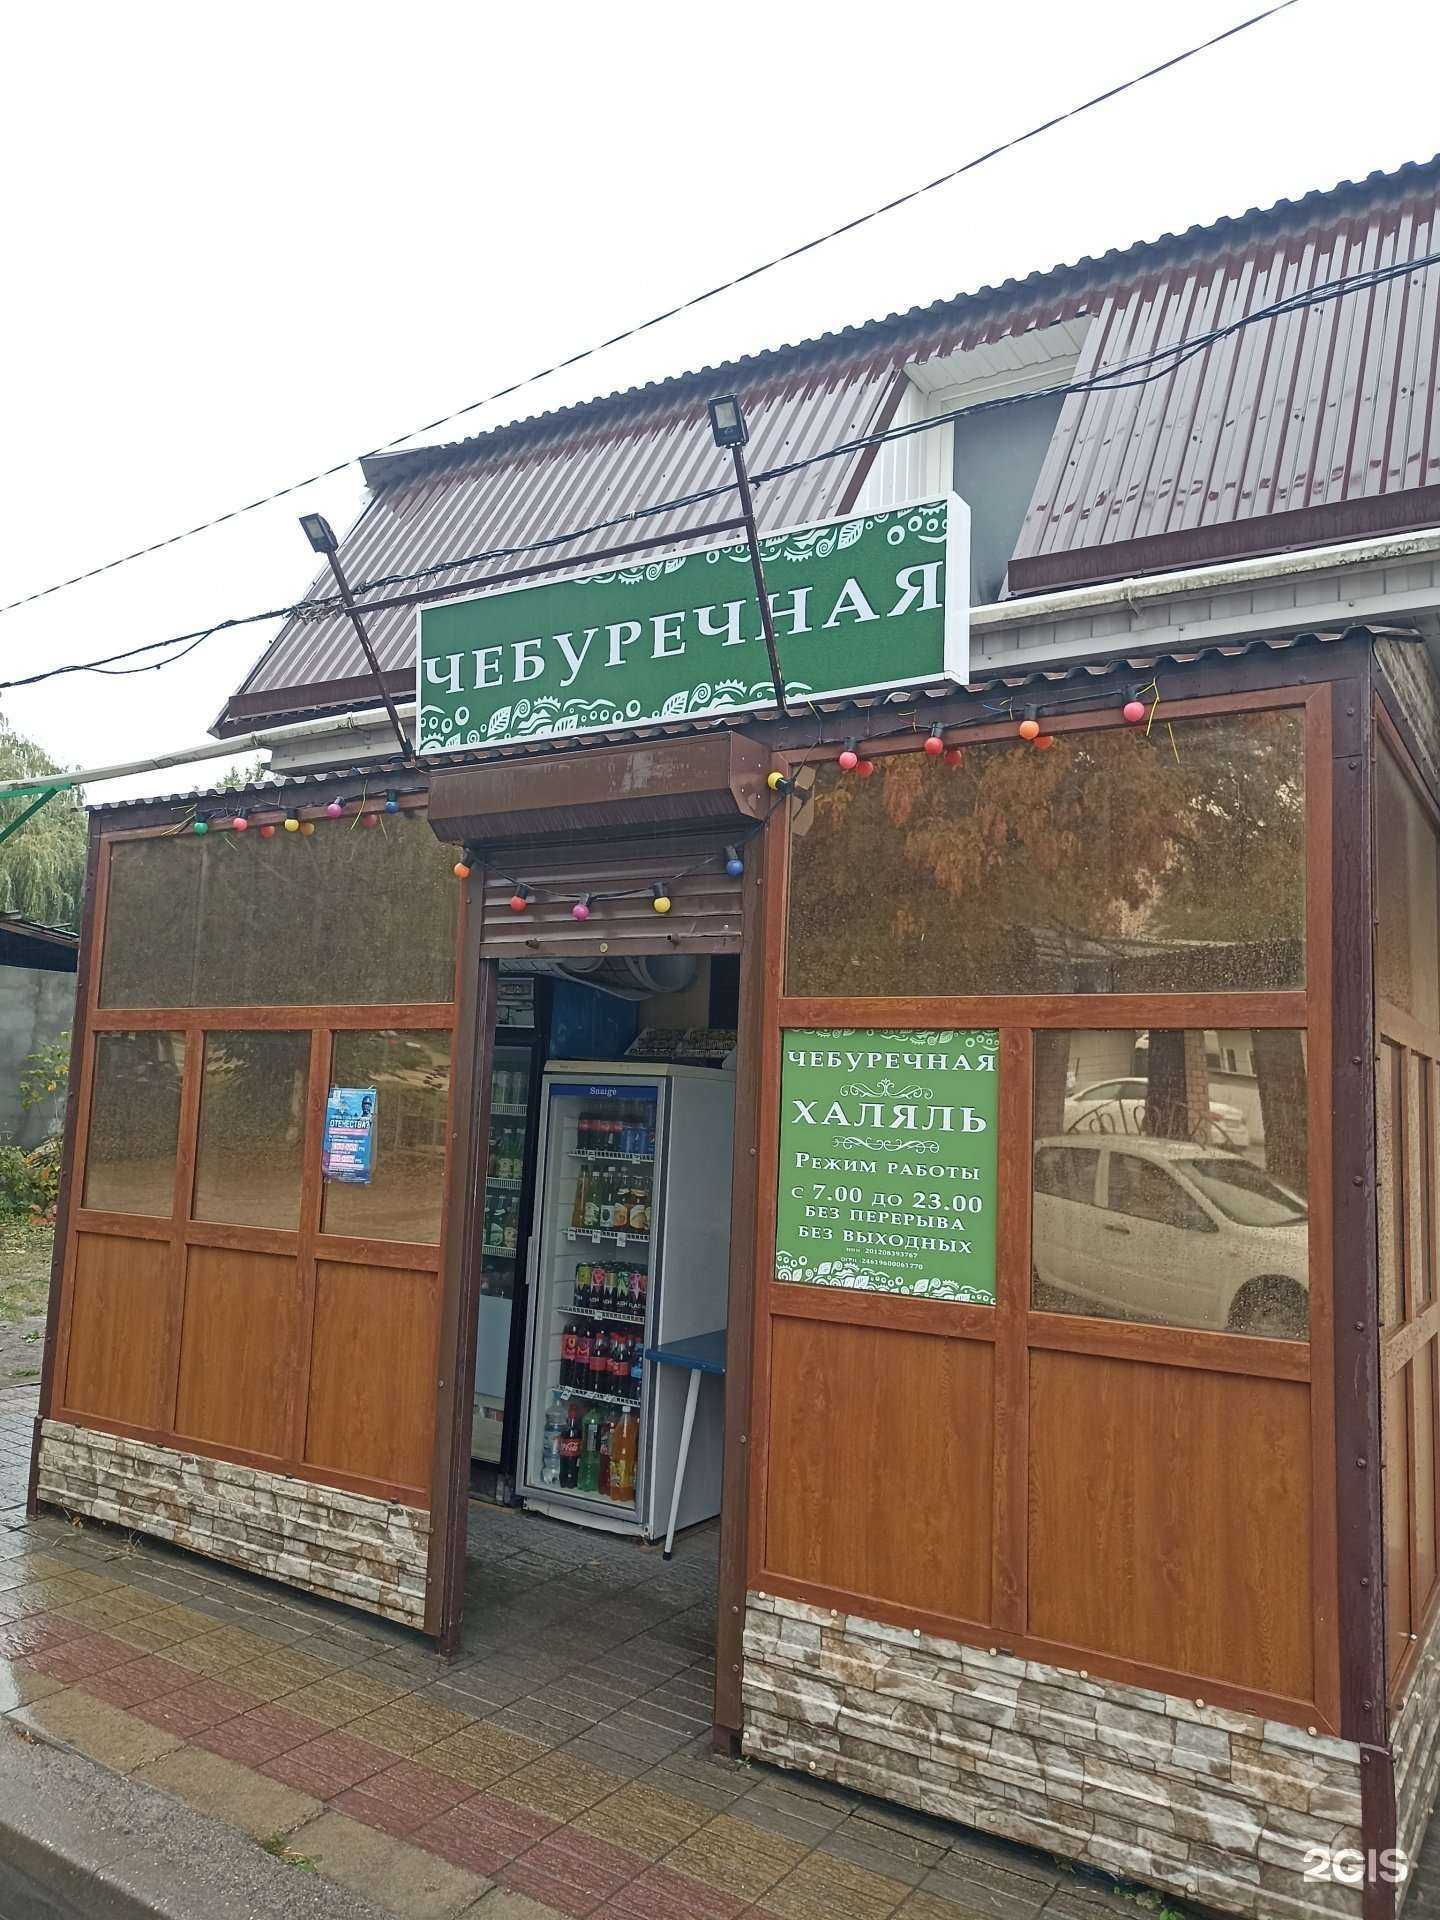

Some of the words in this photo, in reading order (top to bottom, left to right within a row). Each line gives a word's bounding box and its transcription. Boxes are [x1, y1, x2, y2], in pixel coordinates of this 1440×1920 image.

[422, 560, 944, 695] ЧЕБУРЕЧНАЯ
[787, 1051, 995, 1072] ЧЕБУРЕЧНАЯ
[791, 1100, 988, 1133] ХАЛЯЛЬ
[795, 1152, 878, 1173] РЕЖИМ
[887, 1162, 980, 1180] РАБОТЫ
[812, 1184, 862, 1203] 7.00
[871, 1192, 903, 1207] ДО
[913, 1192, 983, 1213] 23.00
[805, 1205, 840, 1220] БЕЗ
[850, 1209, 966, 1231] ПЕРЕРЫВА
[799, 1225, 833, 1240] БЕЗ
[842, 1229, 973, 1254] ВЫХОДНЫХ
